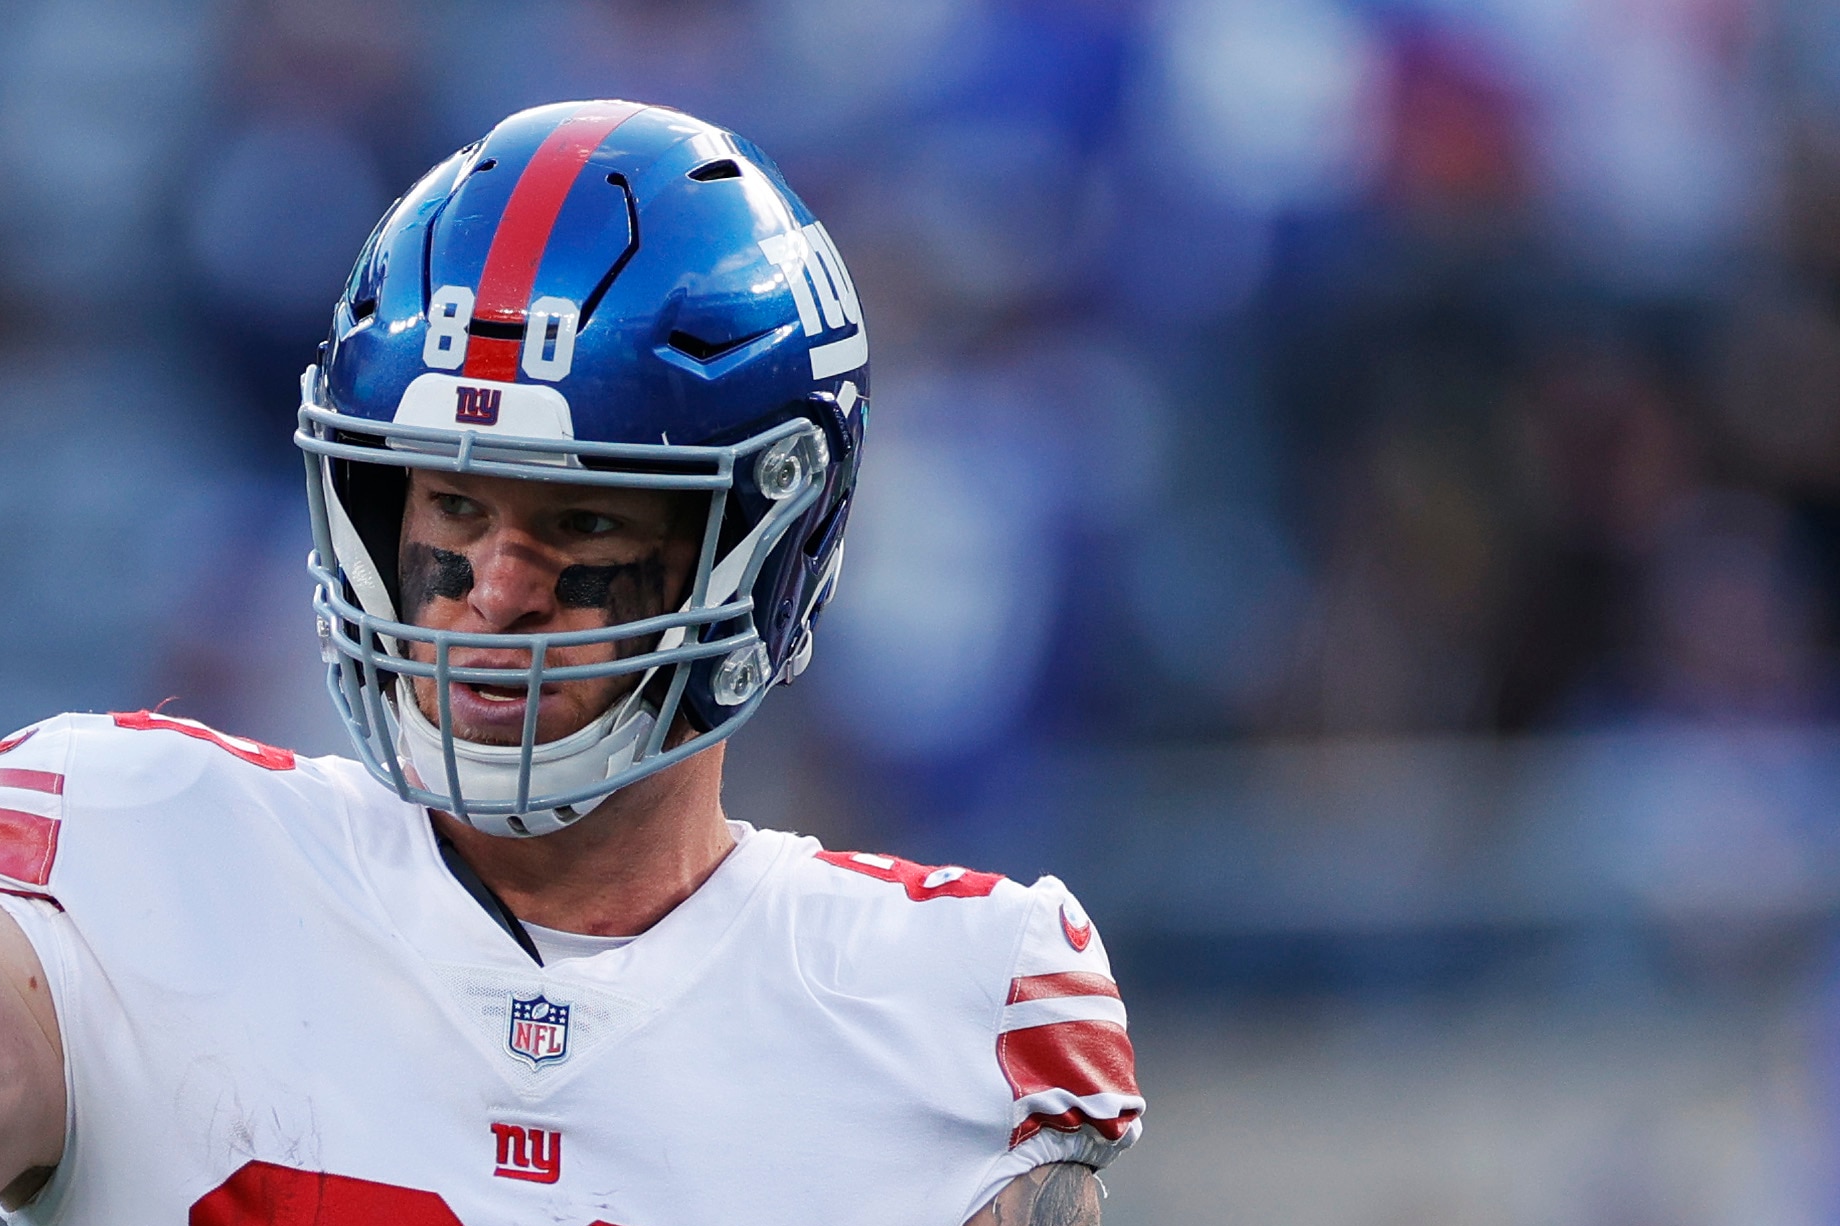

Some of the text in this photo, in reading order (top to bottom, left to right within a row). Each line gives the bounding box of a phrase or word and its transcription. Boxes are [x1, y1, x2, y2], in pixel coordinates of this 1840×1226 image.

[422, 284, 579, 382] 80
[455, 386, 502, 426] ny
[513, 1021, 561, 1056] NFL
[490, 1122, 562, 1185] ny
